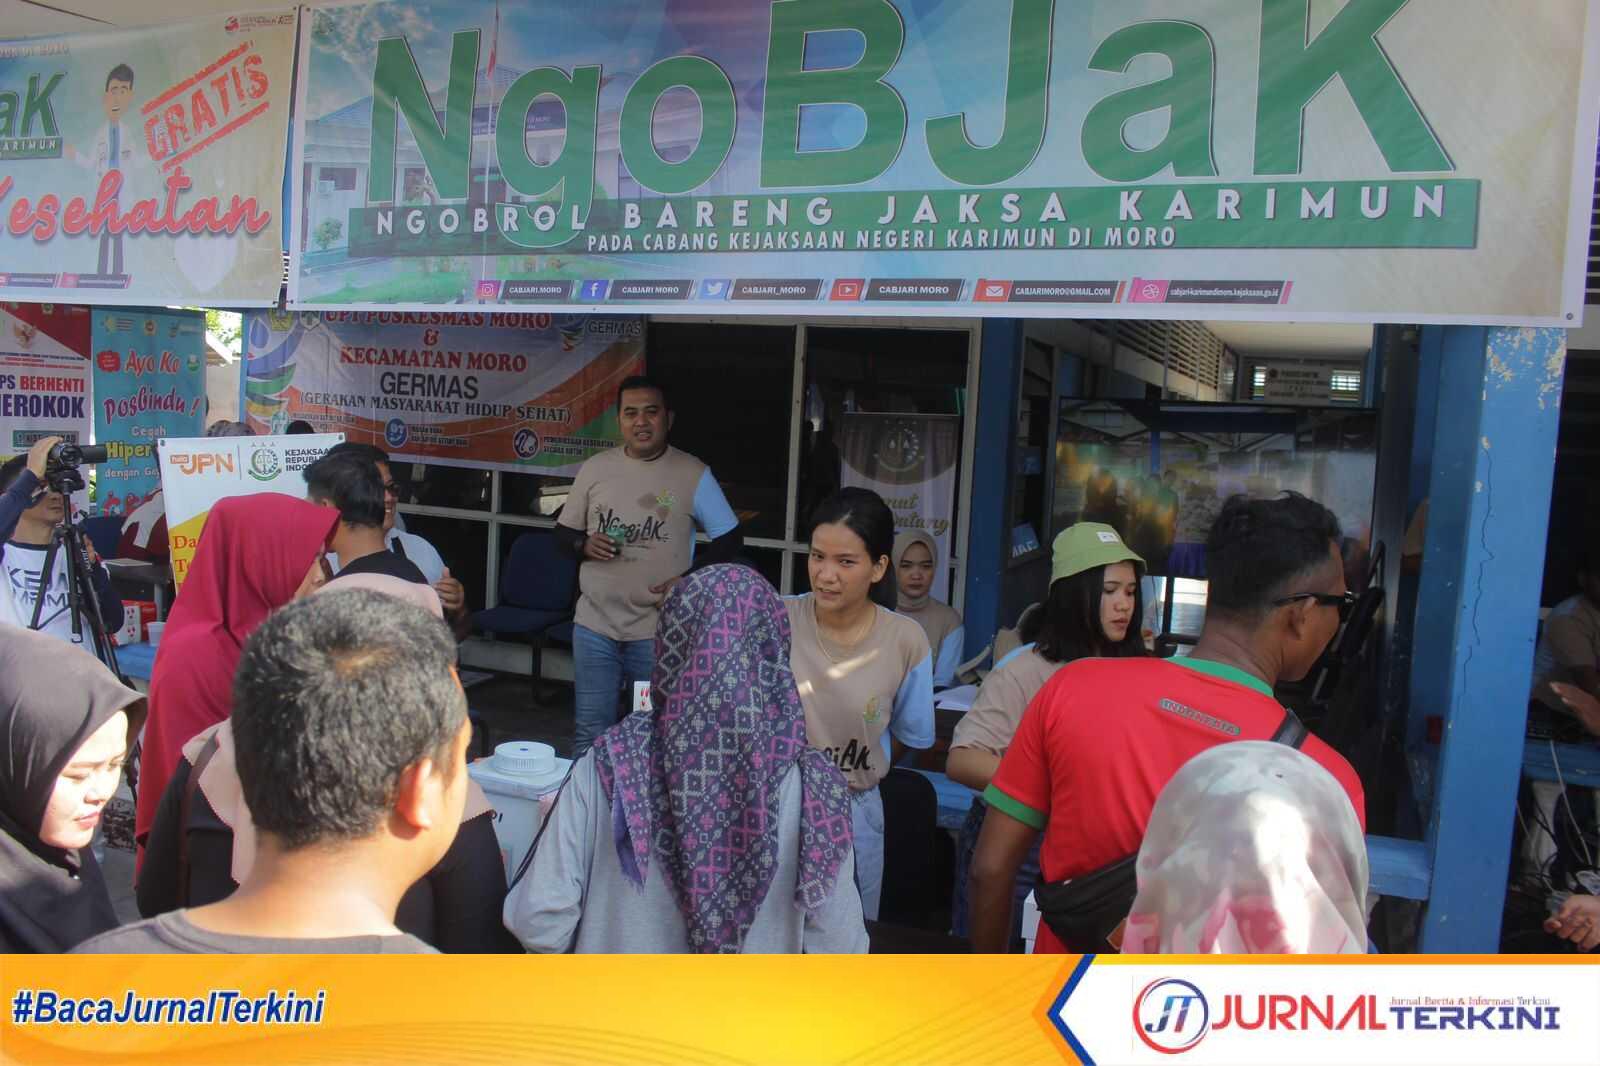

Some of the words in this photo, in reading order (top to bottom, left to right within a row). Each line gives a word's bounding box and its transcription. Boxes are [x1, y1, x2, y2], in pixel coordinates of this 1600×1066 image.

[144, 54, 269, 161] GRATIS
[376, 205, 586, 235] NGOBROL
[624, 197, 833, 229] BARENG
[877, 192, 1067, 225] JAKSA
[1118, 184, 1445, 221] KARIMUN
[588, 233, 633, 252] PADA
[643, 231, 719, 251] CABANG
[729, 230, 845, 251] KEJAKSAAN
[856, 229, 934, 249] NEGERI
[946, 228, 1055, 249] KARIMUN
[1068, 227, 1090, 248] DI
[1104, 226, 1175, 247] MORO
[622, 286, 654, 294] CABJARI
[655, 286, 679, 294] MORO
[878, 286, 919, 294] CABJARI
[920, 286, 950, 294] MORO
[366, 311, 483, 328] PUSKESMAS
[489, 312, 552, 330] MORO
[587, 319, 643, 337] GERMAS
[423, 328, 440, 346] &
[124, 349, 155, 377] Ayo
[340, 345, 462, 370] KECAMATAN
[466, 351, 527, 373] MORO
[20, 375, 85, 393] BERHENTI
[380, 371, 479, 400] GERMAS
[0, 393, 85, 418] EROKOK
[370, 396, 461, 415] MASYARAKAT
[466, 401, 512, 417] HIDUP
[516, 405, 574, 425] SEHAT)
[105, 466, 140, 481] dengan
[180, 453, 234, 476] JPN
